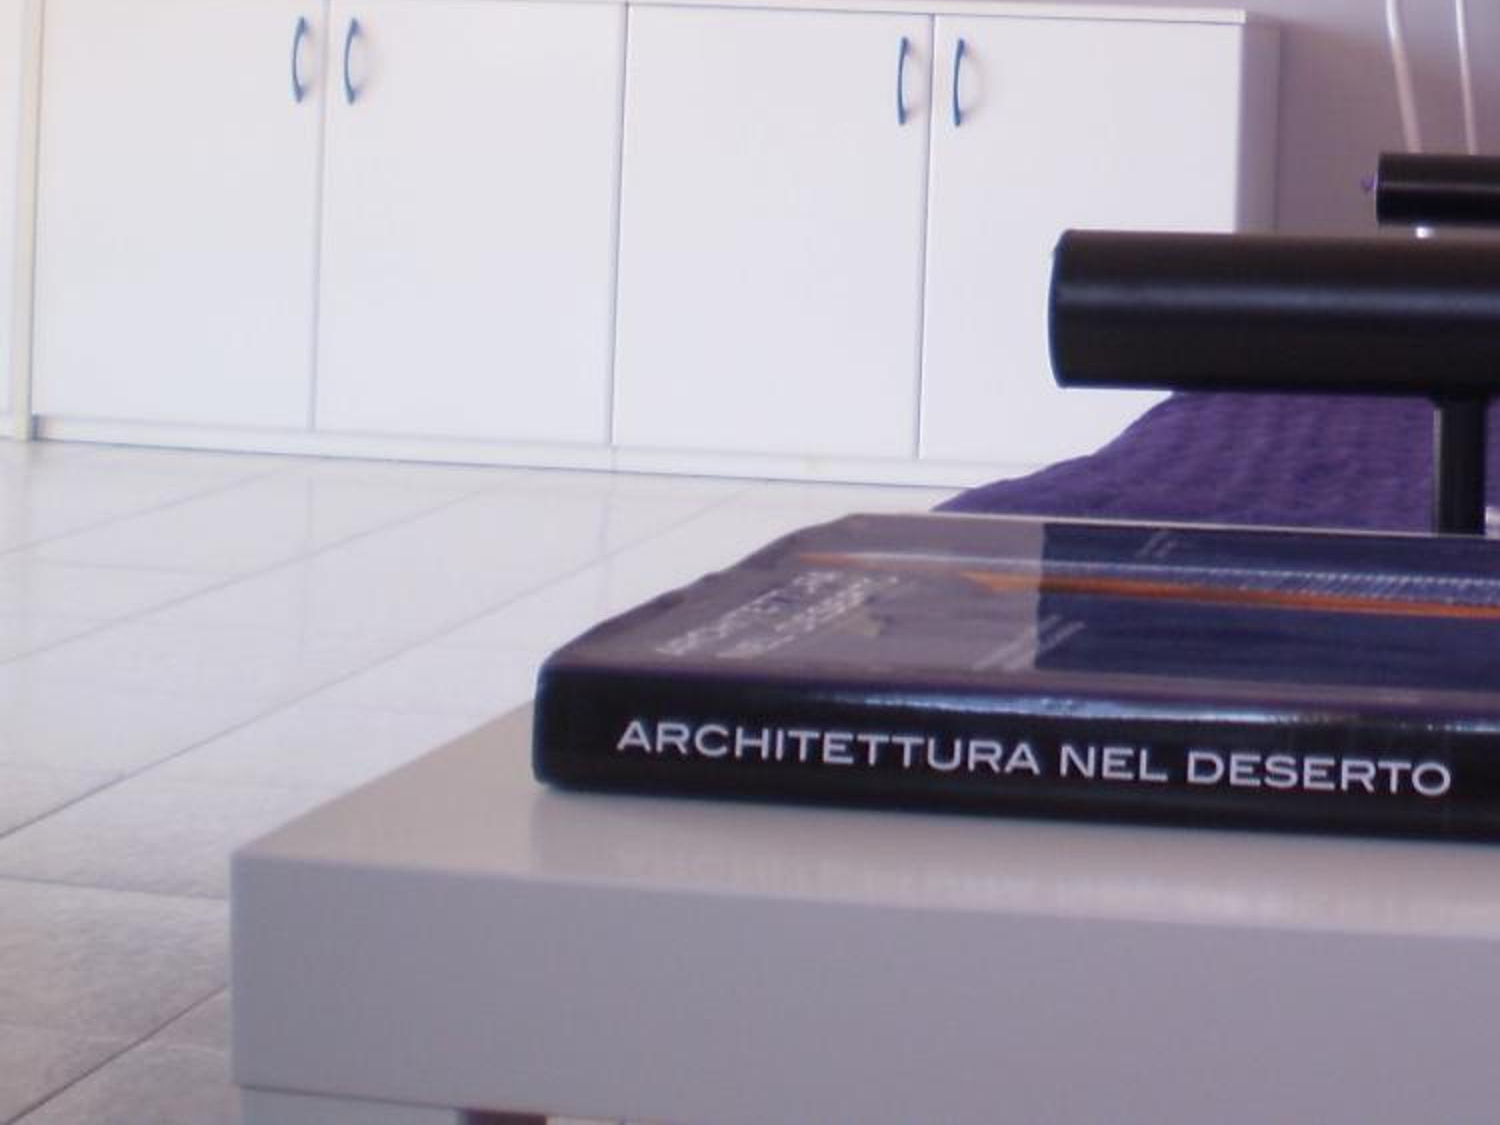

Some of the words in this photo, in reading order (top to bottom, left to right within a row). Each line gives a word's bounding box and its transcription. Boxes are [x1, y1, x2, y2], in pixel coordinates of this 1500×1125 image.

[615, 719, 1041, 775] ARCHITETTURA
[1058, 744, 1168, 783] NEL
[1186, 749, 1453, 797] DESERTO
